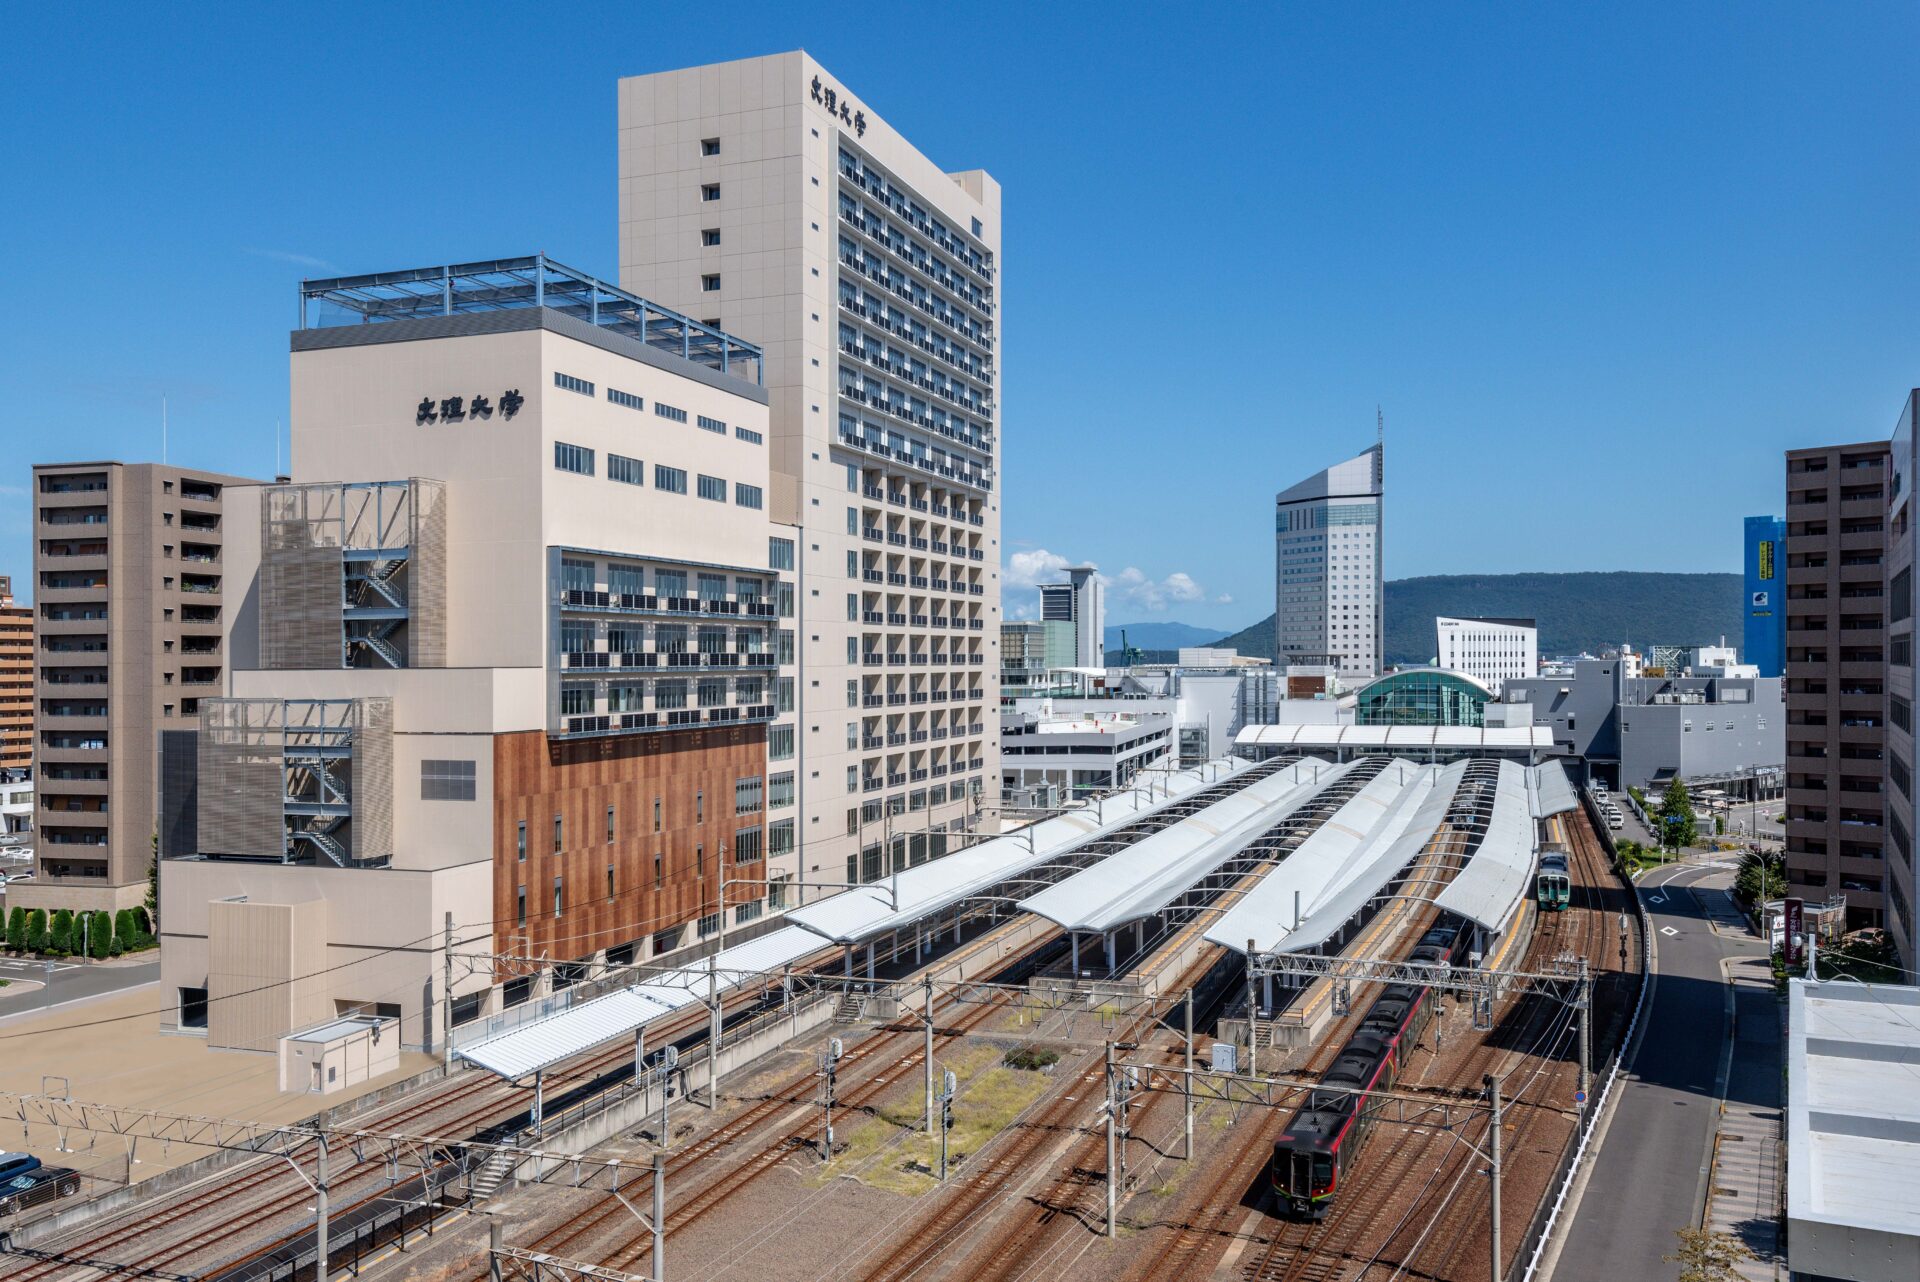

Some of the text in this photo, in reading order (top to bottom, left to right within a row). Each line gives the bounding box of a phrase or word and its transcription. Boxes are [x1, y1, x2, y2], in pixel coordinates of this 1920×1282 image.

[811, 74, 866, 139] 文理大学
[416, 388, 524, 422] 文理大学
